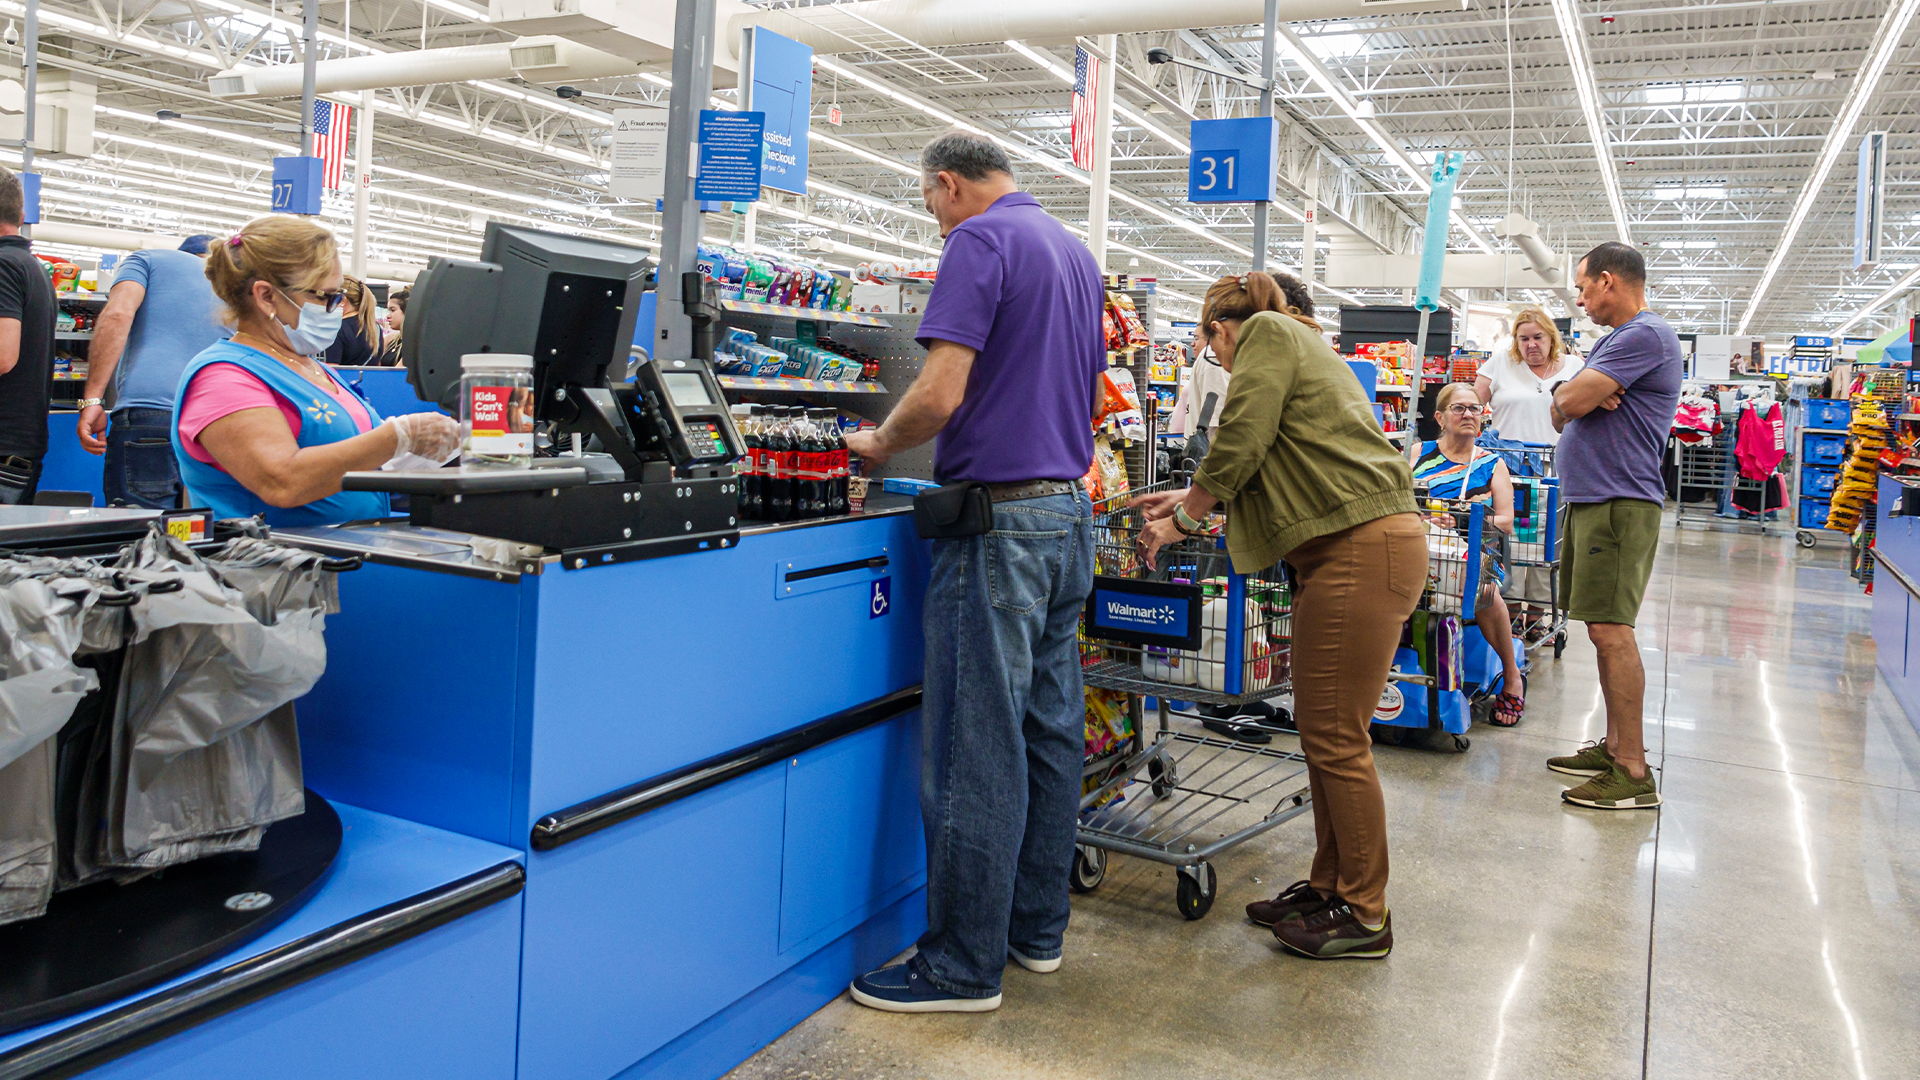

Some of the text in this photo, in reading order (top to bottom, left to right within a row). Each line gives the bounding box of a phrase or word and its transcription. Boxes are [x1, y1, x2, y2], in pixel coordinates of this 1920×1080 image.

[831, 109, 842, 125] EXIT
[1198, 156, 1236, 191] 31
[274, 183, 292, 208] 27
[784, 361, 802, 369] xtra
[475, 392, 497, 402] Kids
[475, 402, 503, 411] Can't
[475, 412, 499, 421] Wait
[1108, 602, 1157, 619] Walmart
